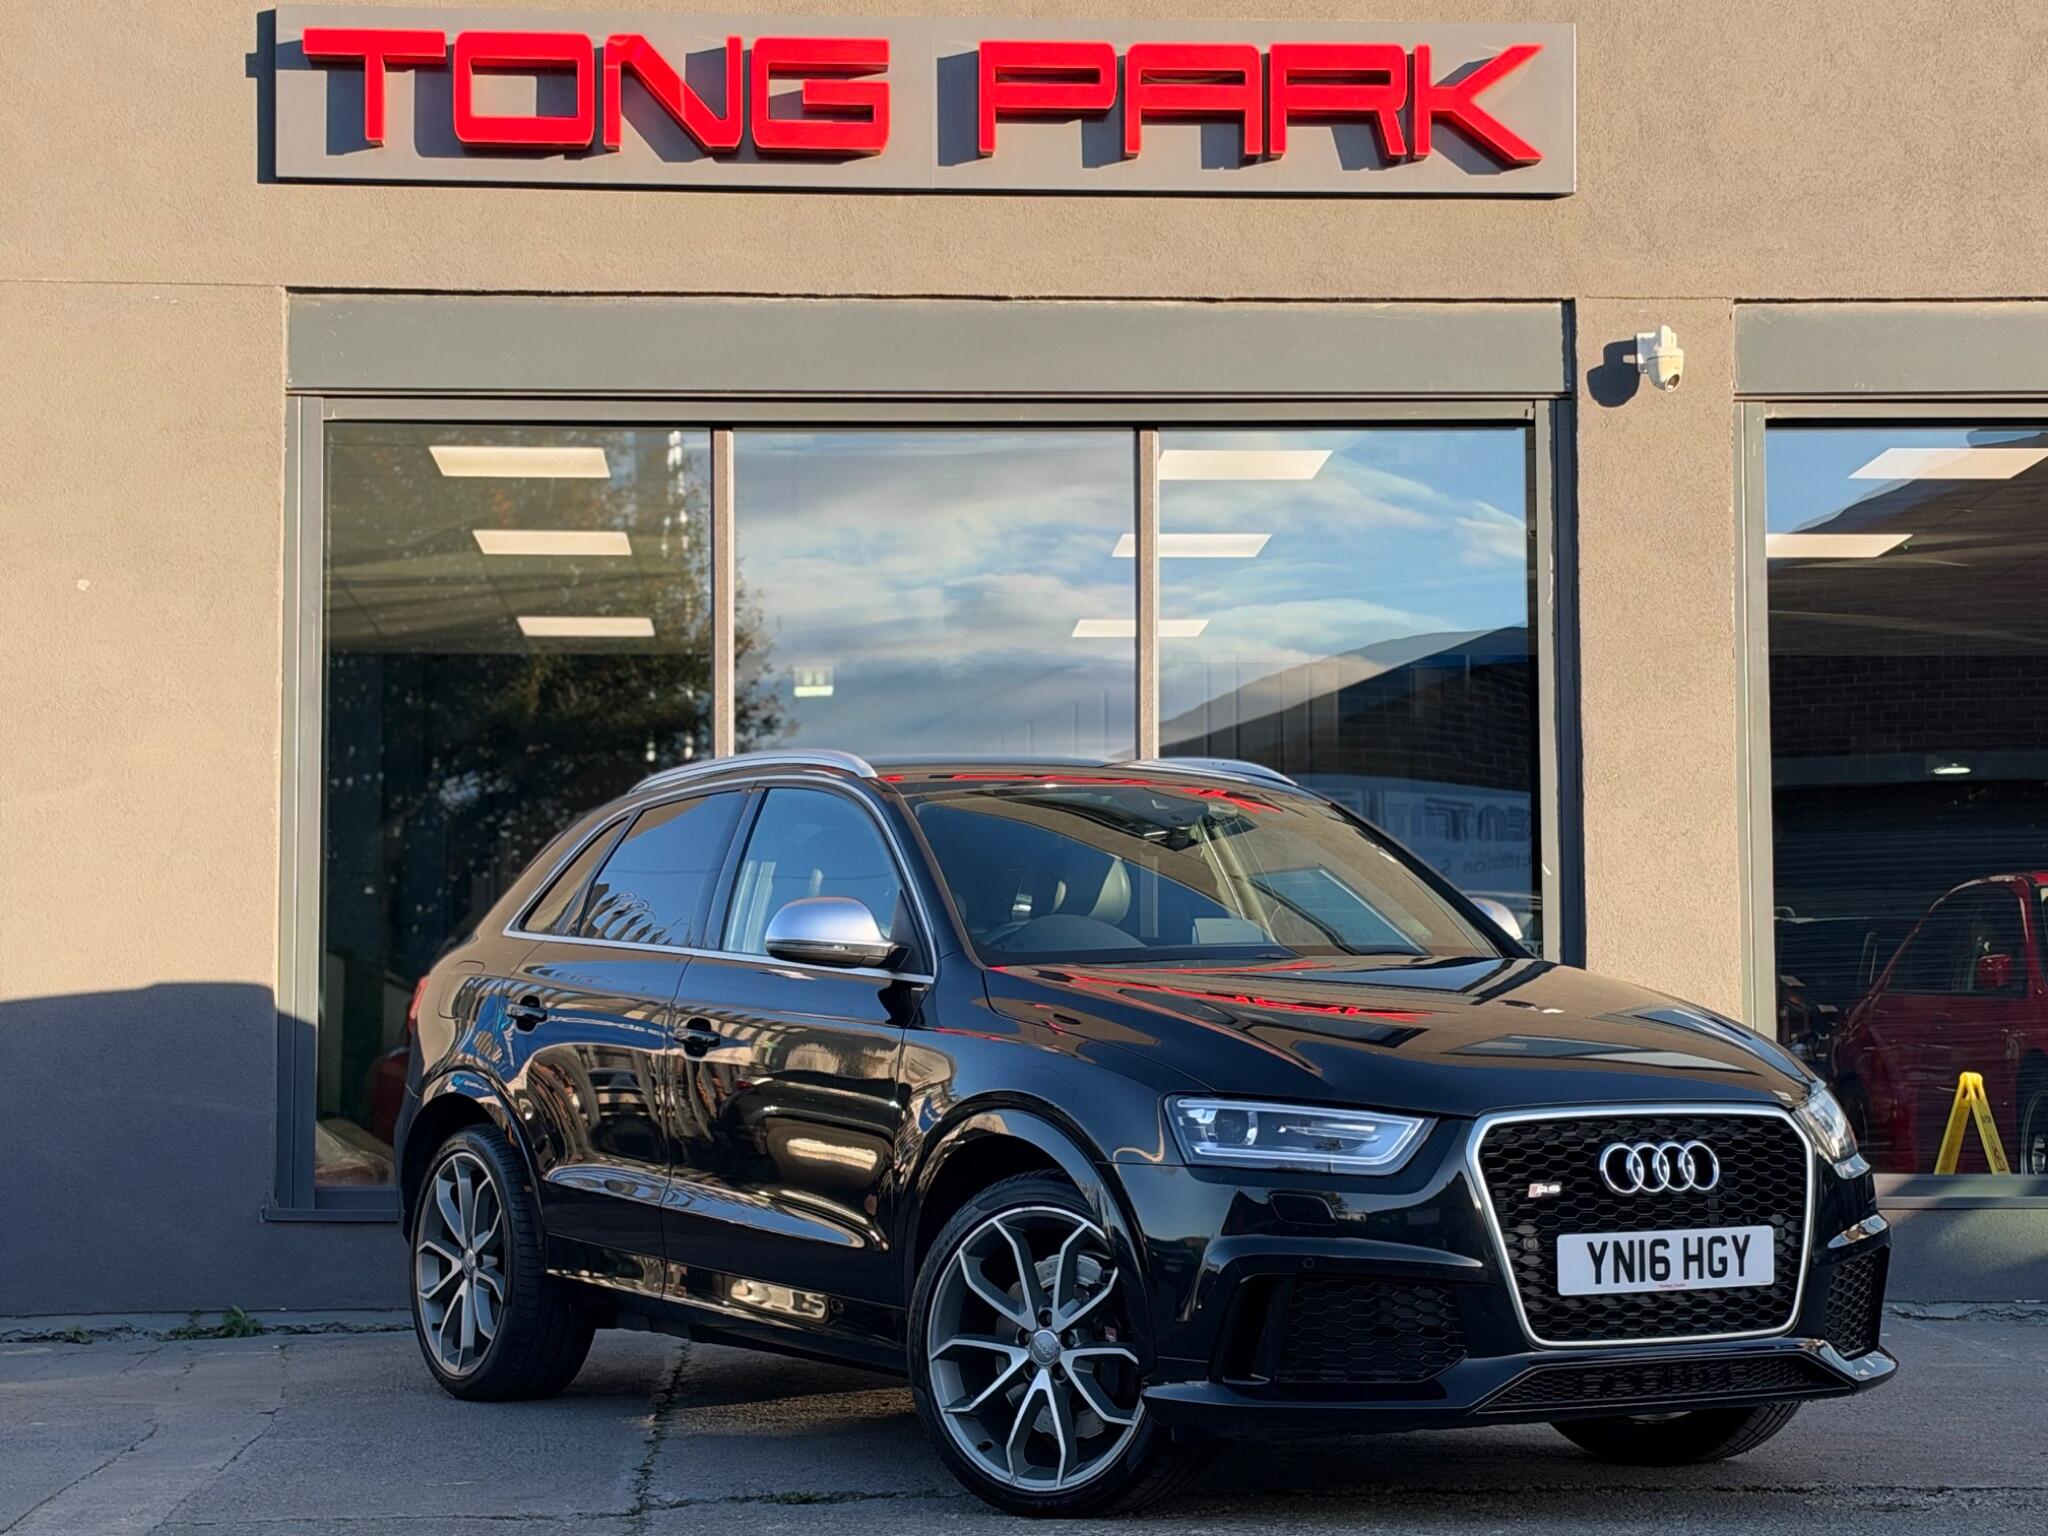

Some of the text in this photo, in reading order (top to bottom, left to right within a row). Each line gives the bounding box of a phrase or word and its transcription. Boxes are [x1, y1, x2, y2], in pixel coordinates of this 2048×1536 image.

[302, 27, 1545, 164] TONG PARK
[1586, 1233, 1751, 1285] YN16 HGY
